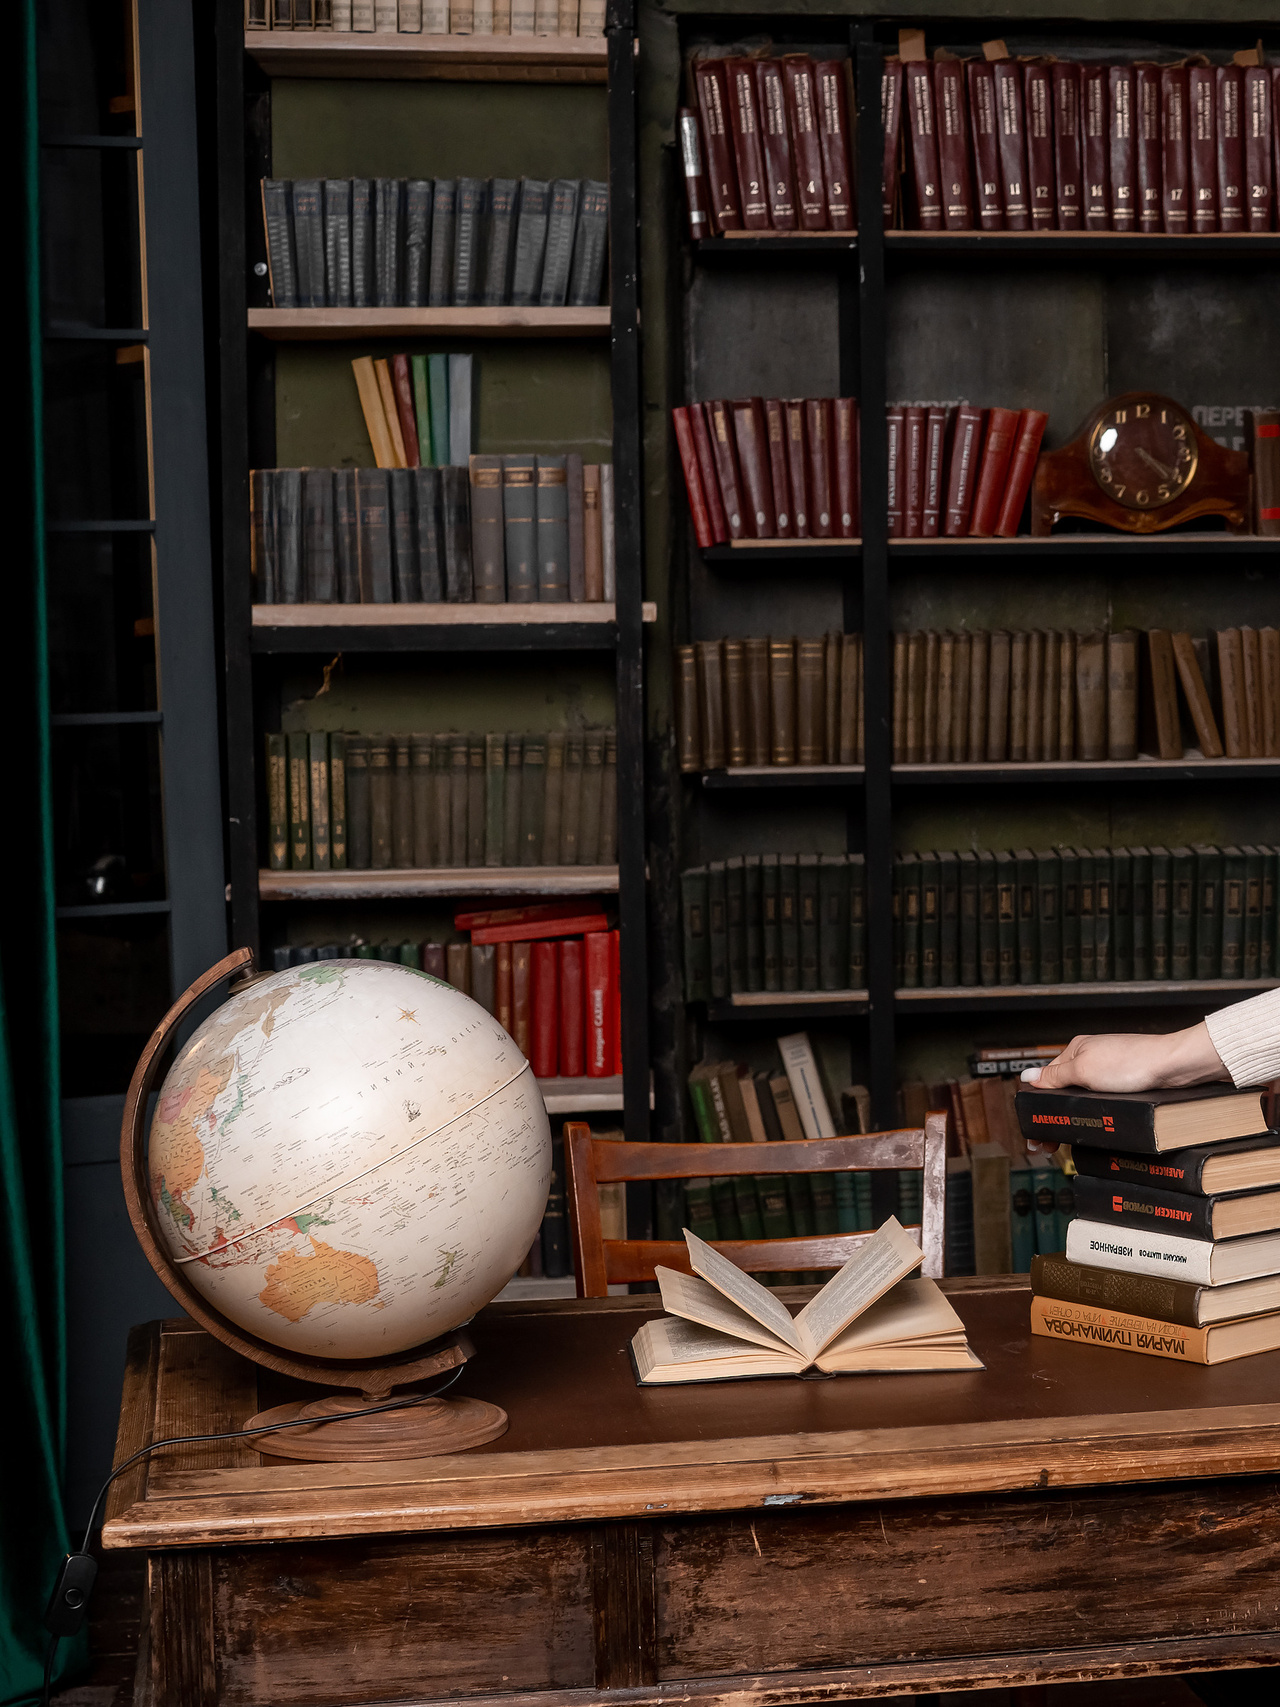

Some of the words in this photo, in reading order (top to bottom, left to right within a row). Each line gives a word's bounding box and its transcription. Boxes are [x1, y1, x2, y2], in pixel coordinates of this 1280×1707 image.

[750, 181, 759, 195] 2
[776, 182, 786, 195] 3
[807, 180, 816, 194] 4
[833, 182, 842, 195] 5
[952, 183, 961, 196] 9
[984, 182, 997, 195] 10
[1010, 183, 1021, 196] 11
[1036, 186, 1048, 198] 12
[1064, 184, 1076, 196] 13
[1118, 186, 1130, 199] 15
[1252, 185, 1268, 198] 20
[1171, 188, 1183, 201] 17
[1116, 410, 1126, 424] 11
[1136, 404, 1150, 418] 12
[1161, 410, 1167, 424] 1
[1173, 425, 1186, 440] 2
[1179, 447, 1191, 462] 3
[1114, 484, 1126, 498] 7
[1136, 490, 1149, 504] 6
[1158, 484, 1170, 499] 5
[357, 1061, 415, 1098] ТИХИЙ
[451, 1021, 482, 1043] ОКЕАН
[1032, 1114, 1071, 1126] АЛЕКСЕЙ
[1071, 1117, 1103, 1128] СУРКОВ
[1118, 1159, 1148, 1172] СУРКОВ
[1149, 1165, 1184, 1179] АЛЕКСЕЙ
[1123, 1201, 1154, 1214] СУРКОВ
[1155, 1206, 1192, 1222] АЛЕКСЕЙ
[1090, 1240, 1133, 1258] ИЗБРАННОЕ
[1139, 1249, 1162, 1260] ШАТРОВ
[1163, 1252, 1188, 1264] МИХАИЛ
[289, 1276, 326, 1296] АВСТРАЛИЯ
[1043, 1318, 1132, 1347] ПУЙМАНОВА
[1146, 1321, 1157, 1333] НА
[1136, 1333, 1185, 1355] МАРИЯ
